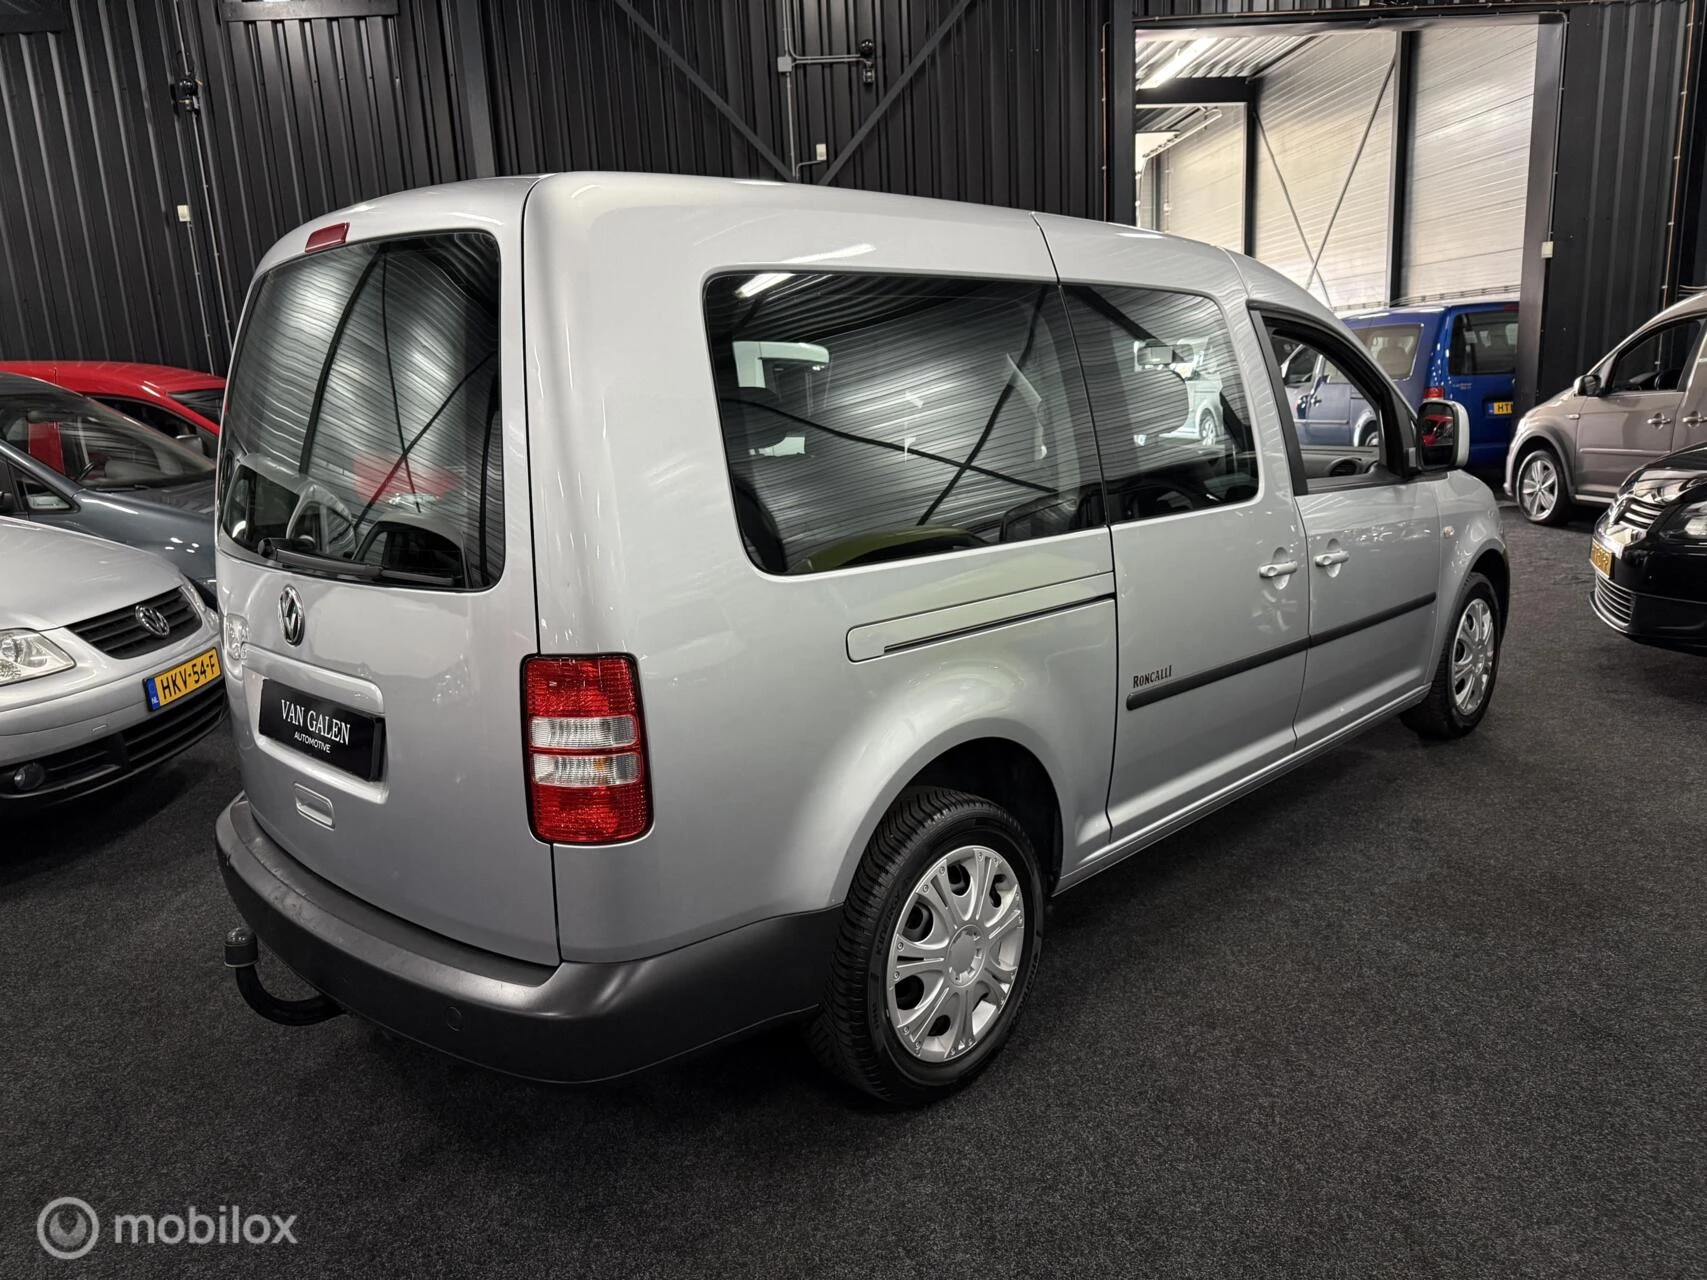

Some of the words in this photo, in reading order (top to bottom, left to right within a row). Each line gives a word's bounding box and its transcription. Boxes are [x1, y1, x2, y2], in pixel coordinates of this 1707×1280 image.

[160, 654, 216, 700] HKV-54-F
[280, 699, 304, 727] VAN
[307, 710, 351, 746] GALEN
[294, 731, 331, 753] AUTOMOTIVE
